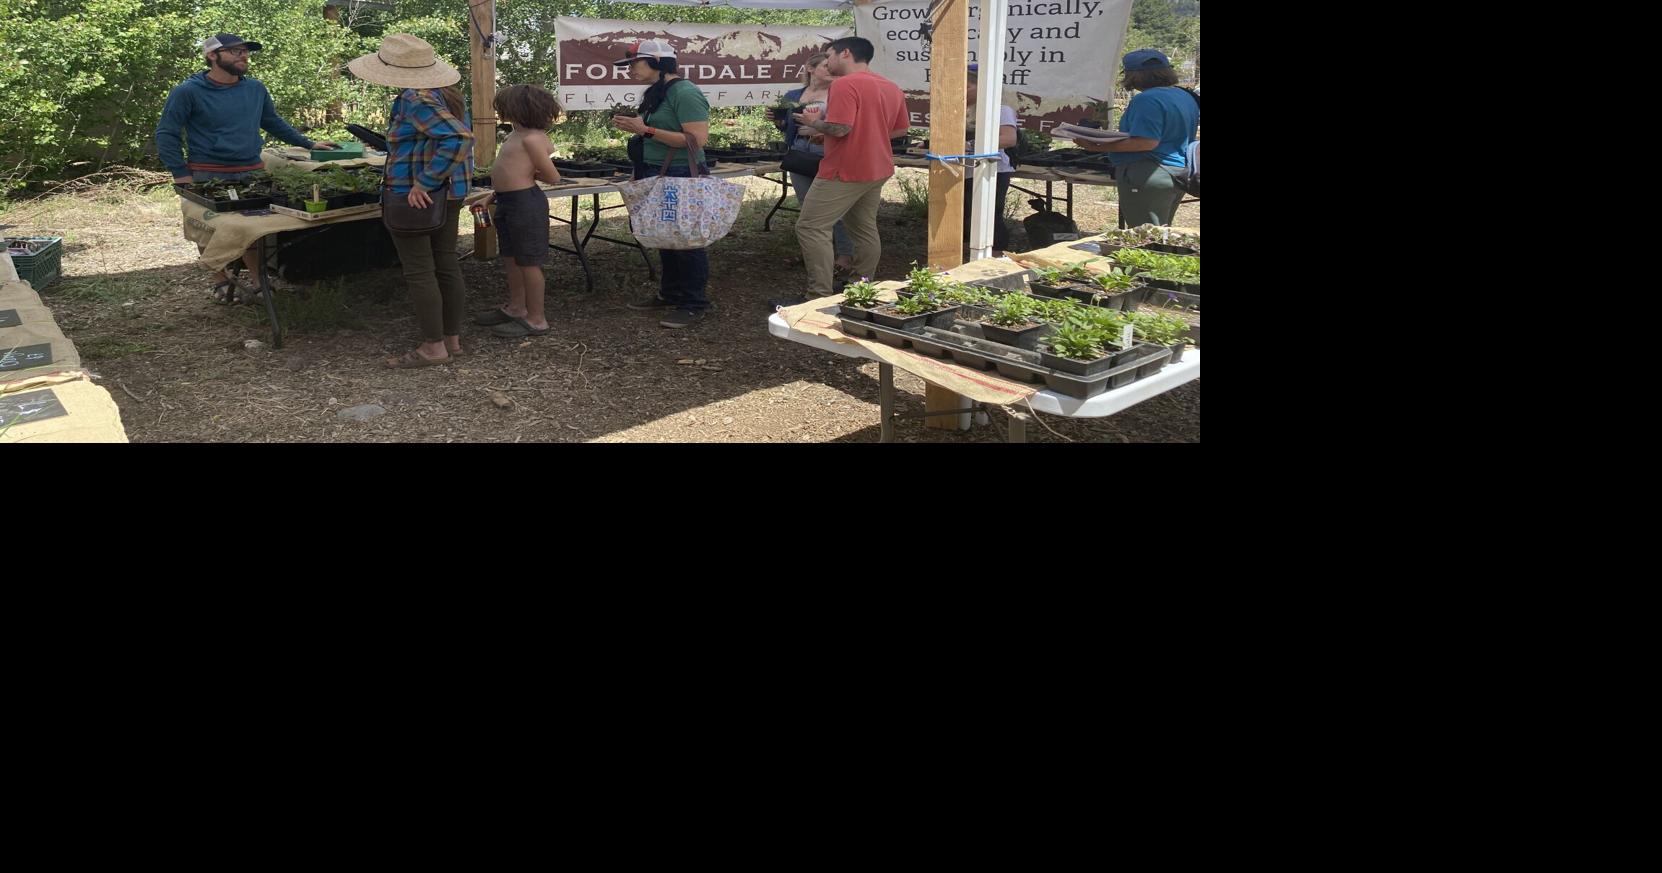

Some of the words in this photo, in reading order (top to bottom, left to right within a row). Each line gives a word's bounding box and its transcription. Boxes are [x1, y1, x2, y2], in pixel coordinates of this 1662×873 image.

[1030, 22, 1080, 39] and
[1039, 46, 1066, 62] in
[565, 63, 771, 80] FORTDALE
